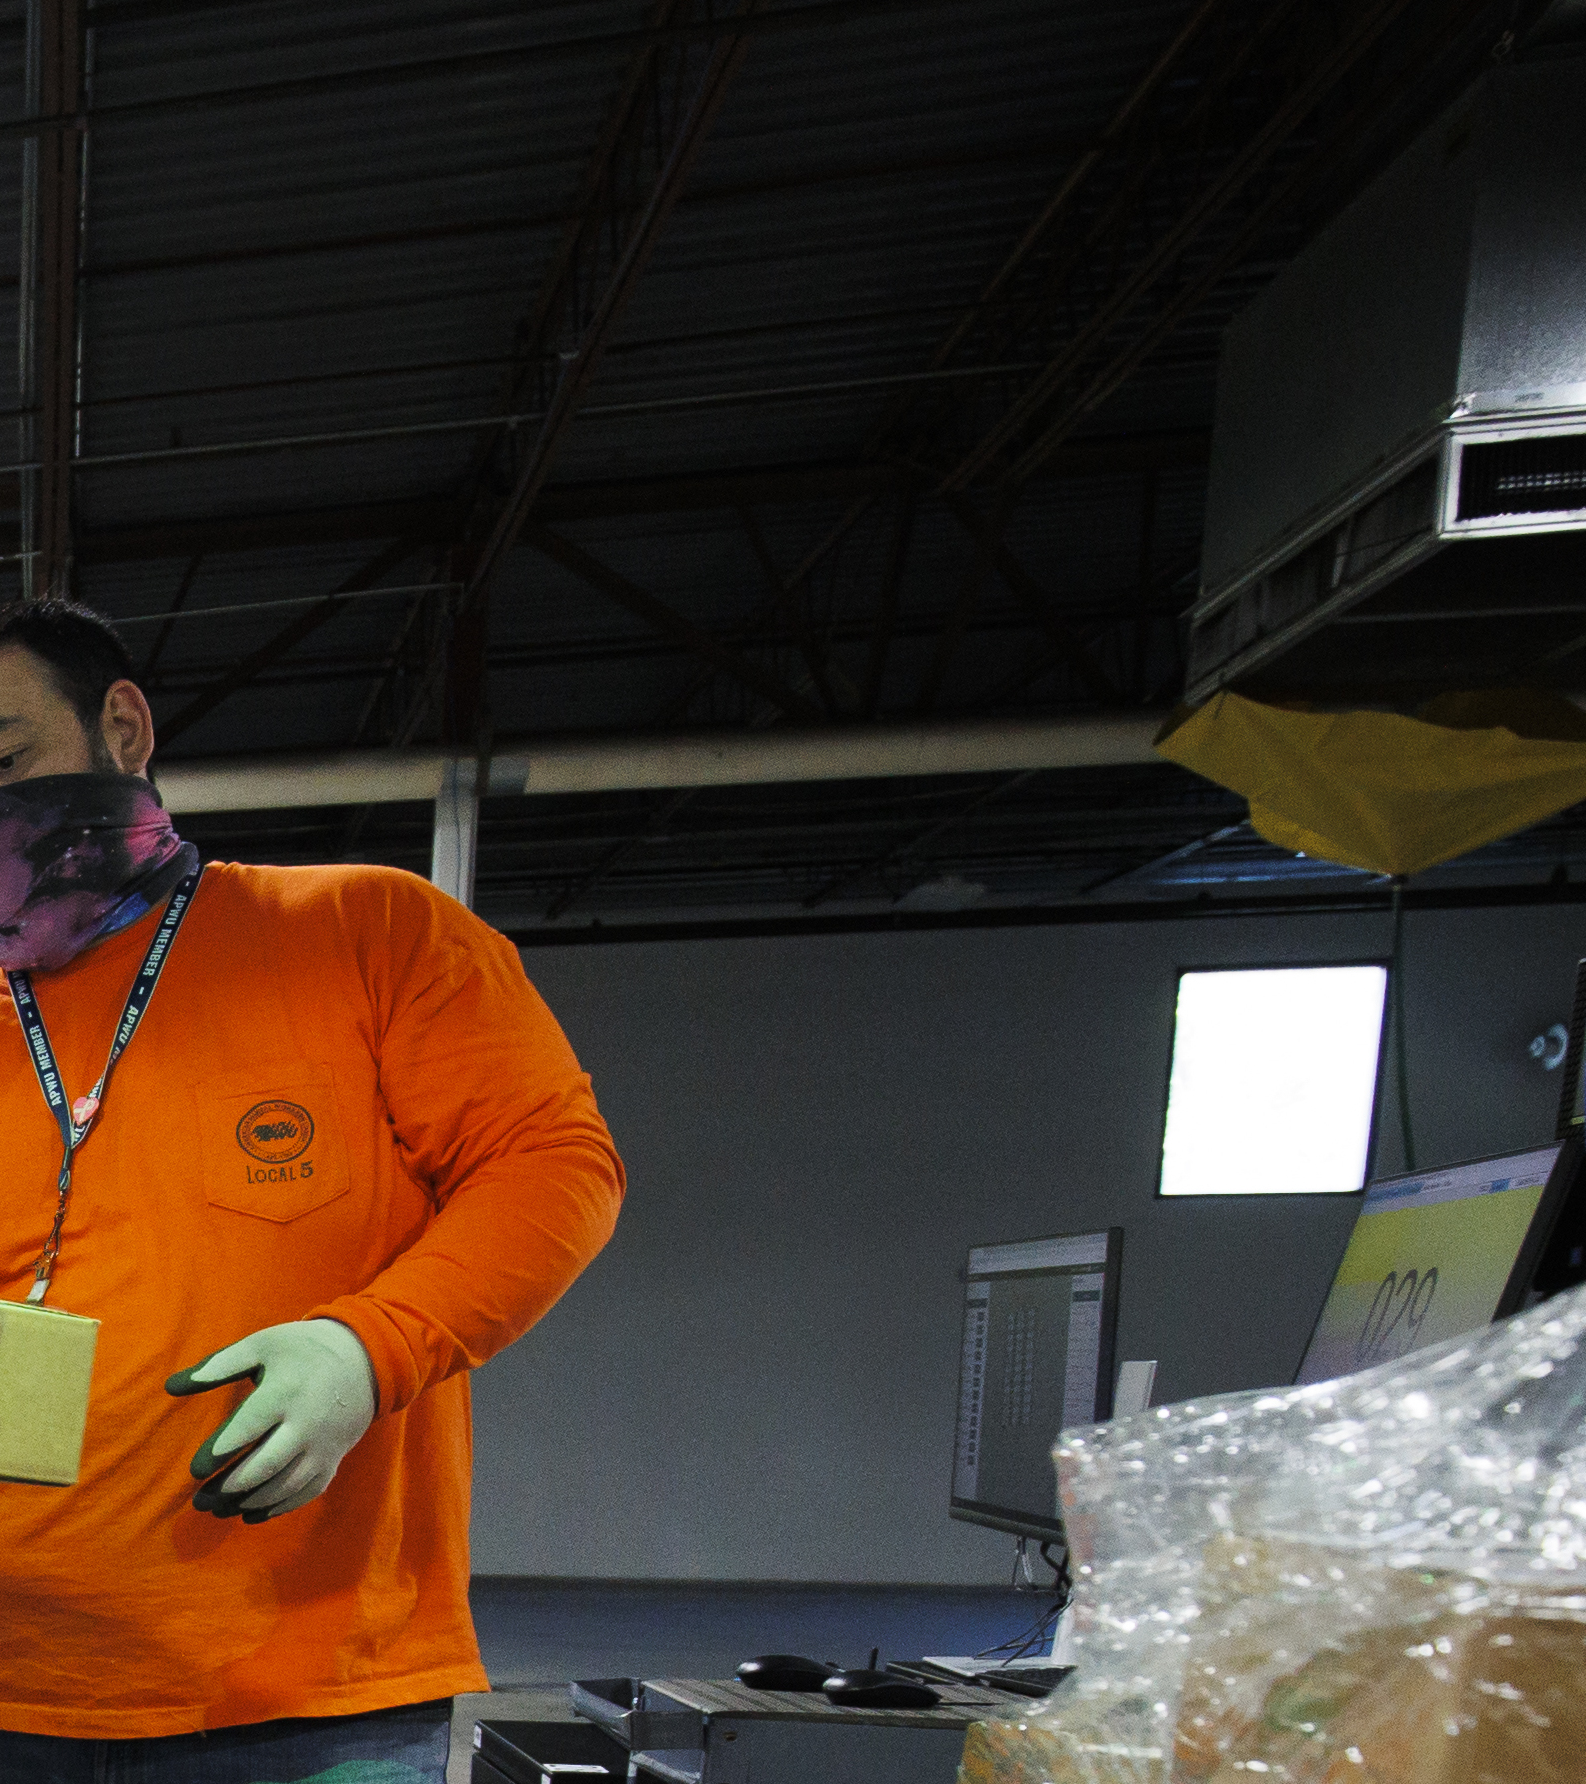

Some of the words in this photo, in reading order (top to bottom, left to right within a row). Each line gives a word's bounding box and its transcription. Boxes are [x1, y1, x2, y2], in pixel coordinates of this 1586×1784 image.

[164, 894, 187, 925] APWU
[142, 928, 172, 977] MEMBER
[29, 1024, 52, 1071] MEMBER
[43, 1071, 62, 1106] APWU
[246, 1166, 297, 1184] LOCAL
